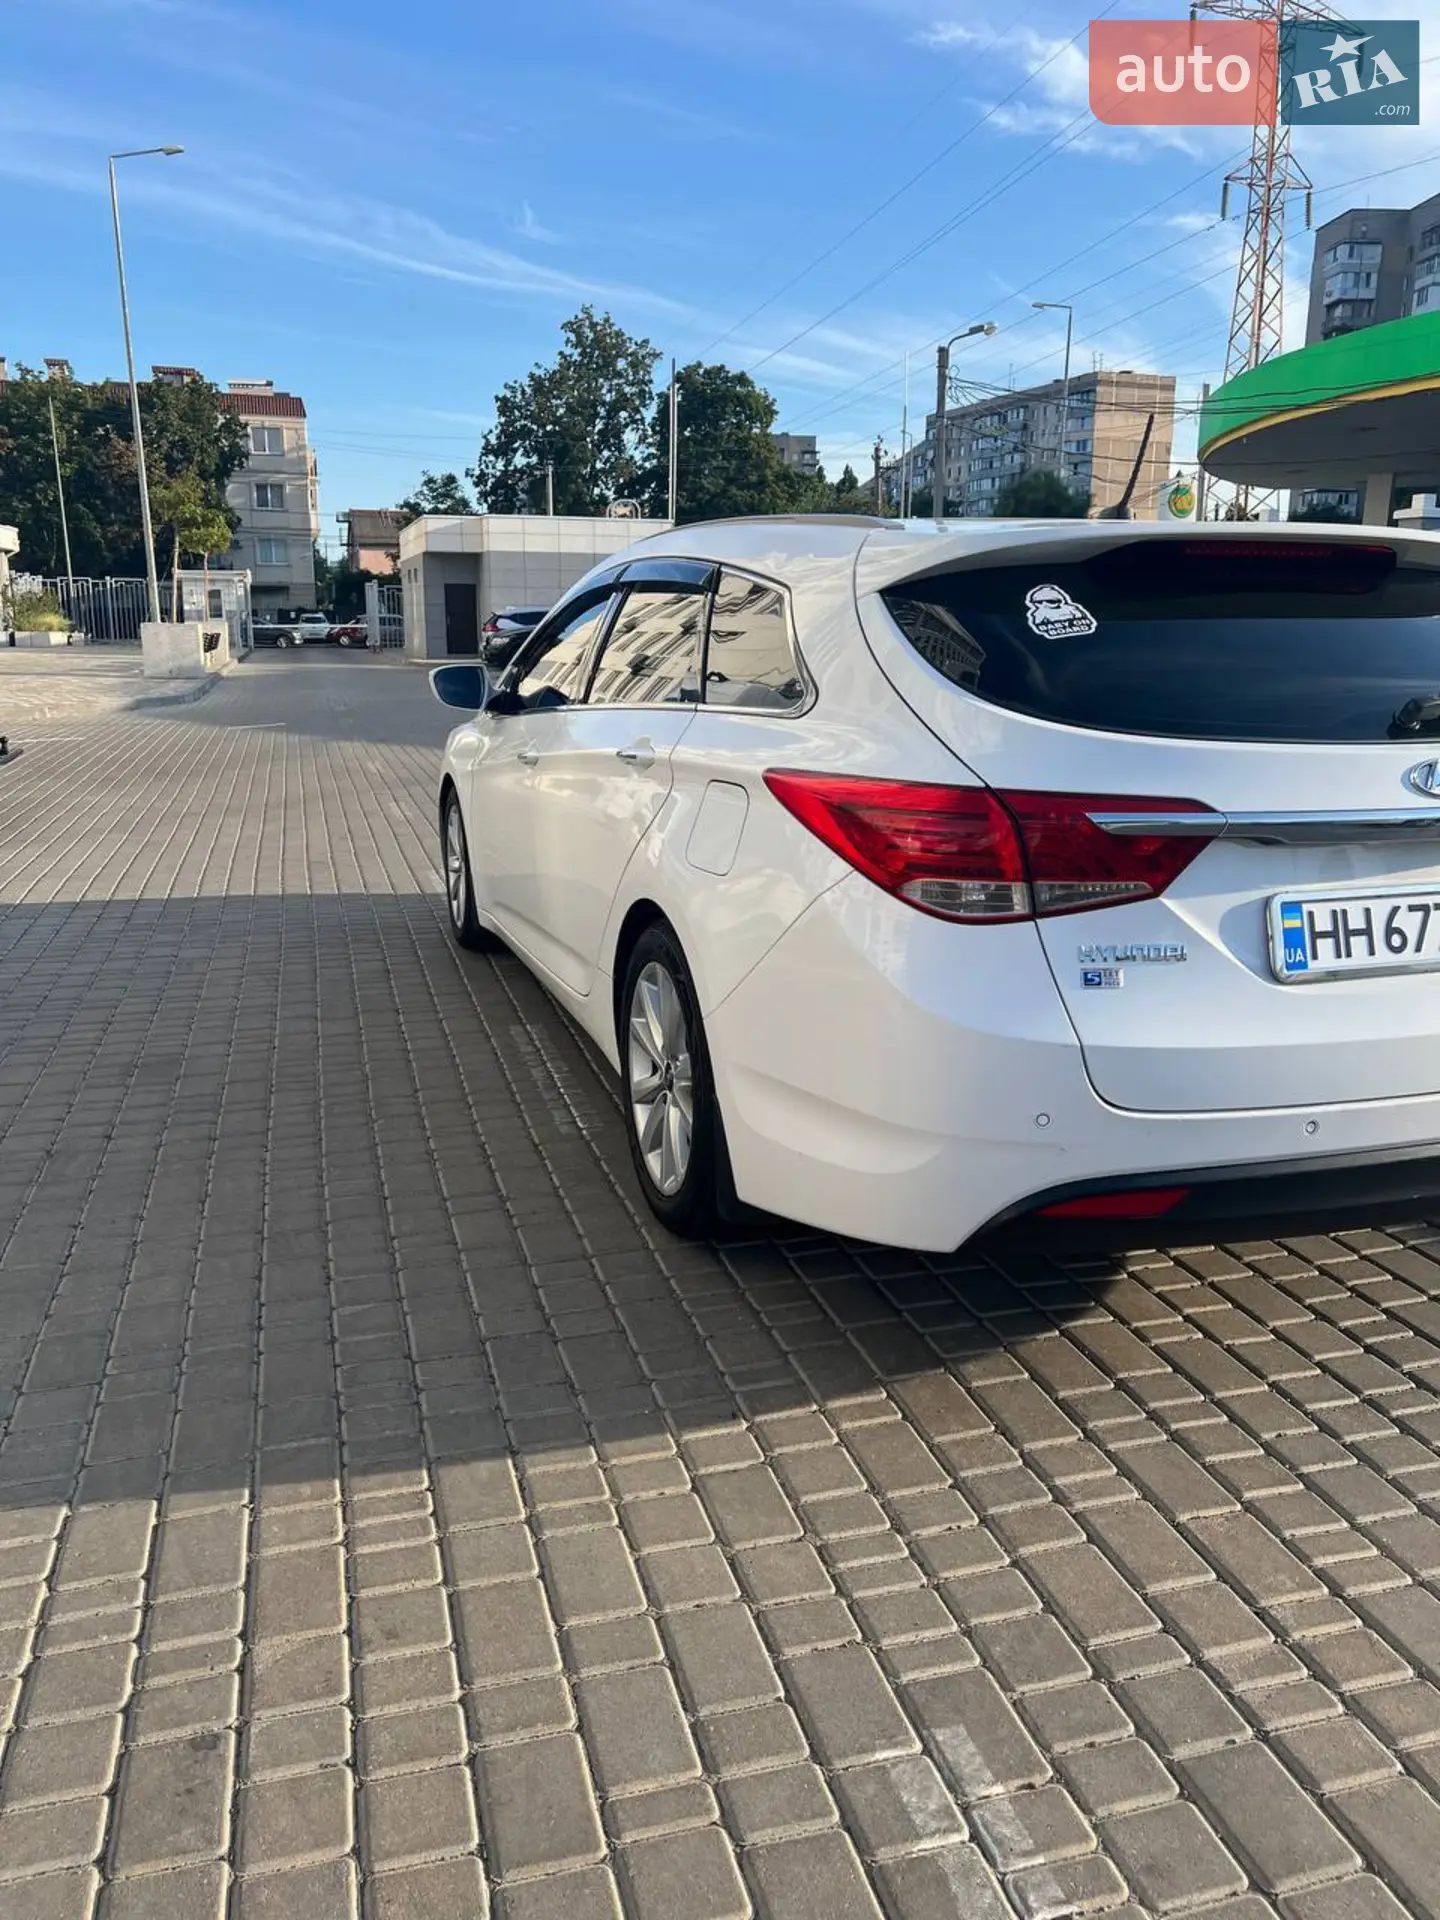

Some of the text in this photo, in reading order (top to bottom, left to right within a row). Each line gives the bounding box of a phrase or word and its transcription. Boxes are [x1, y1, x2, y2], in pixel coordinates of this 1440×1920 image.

[1038, 618, 1091, 632] BABY ON
[1048, 624, 1089, 636] BOARD
[1307, 902, 1440, 961] HH 67
[1079, 942, 1188, 963] HYUNDAI
[1285, 947, 1306, 963] UA
